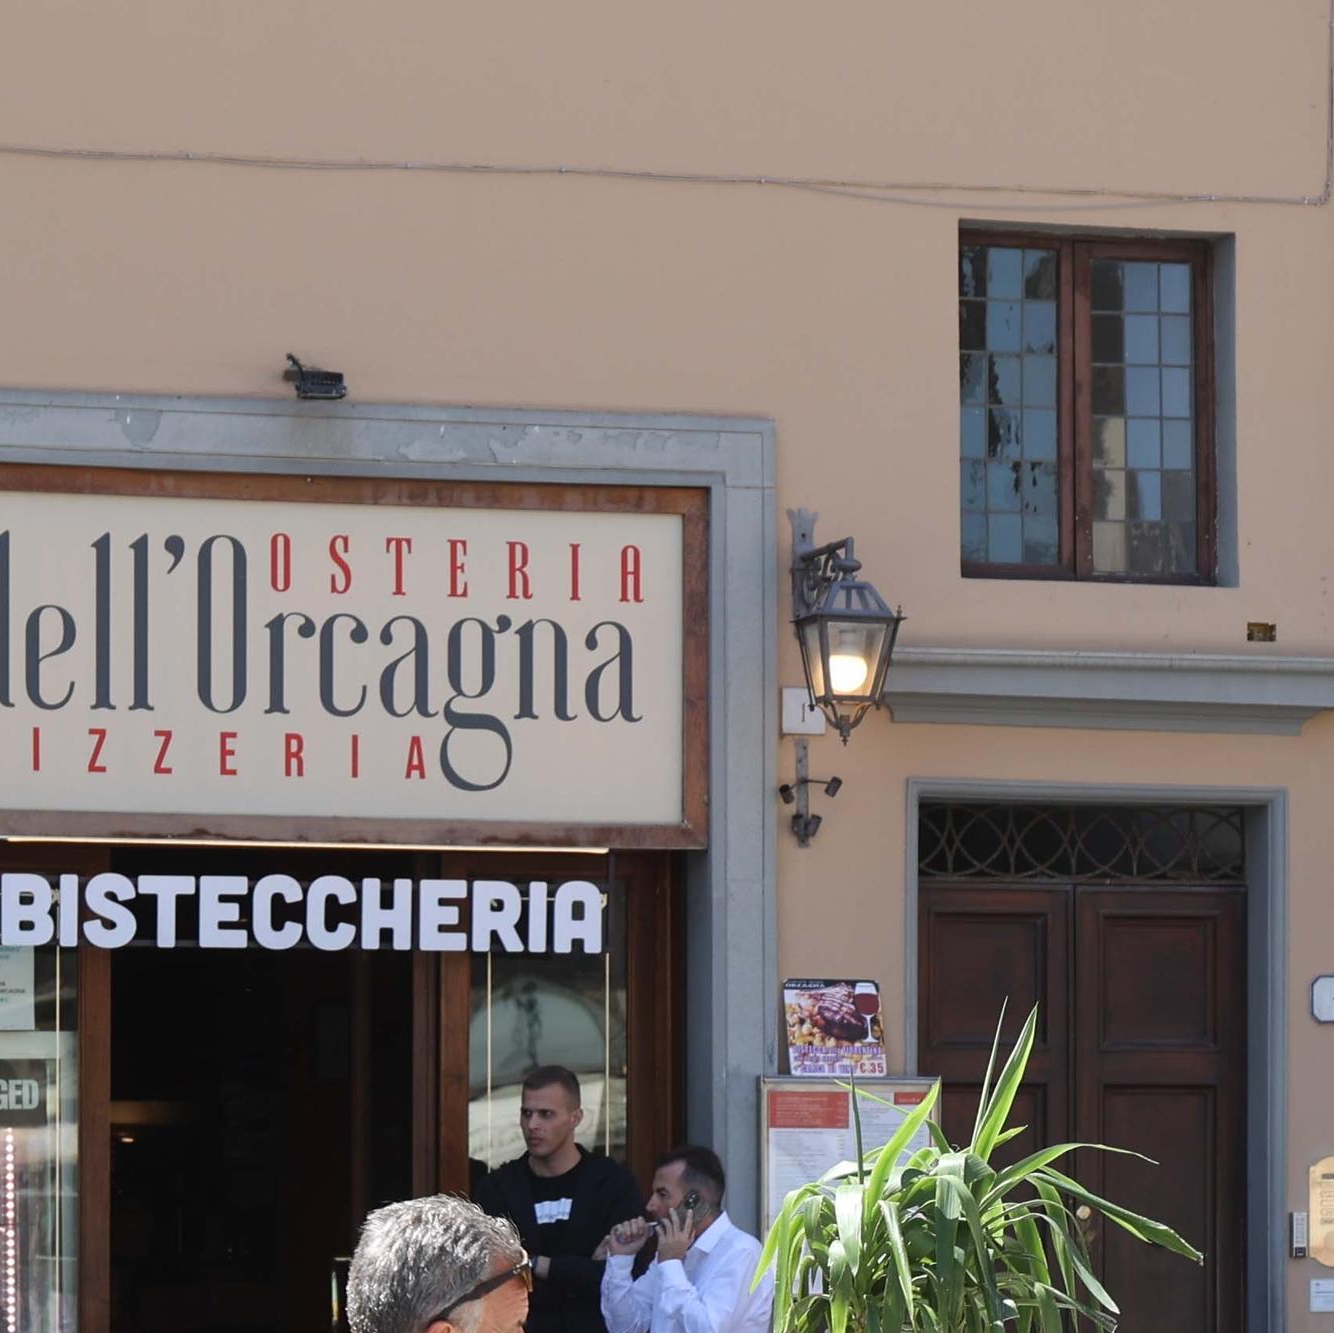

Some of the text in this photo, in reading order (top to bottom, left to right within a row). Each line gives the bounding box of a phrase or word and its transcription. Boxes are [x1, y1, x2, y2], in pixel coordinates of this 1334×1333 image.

[269, 531, 644, 603] OSTERIA
[0, 872, 603, 954] BISTECCHERIA
[870, 1061, 884, 1074] 35
